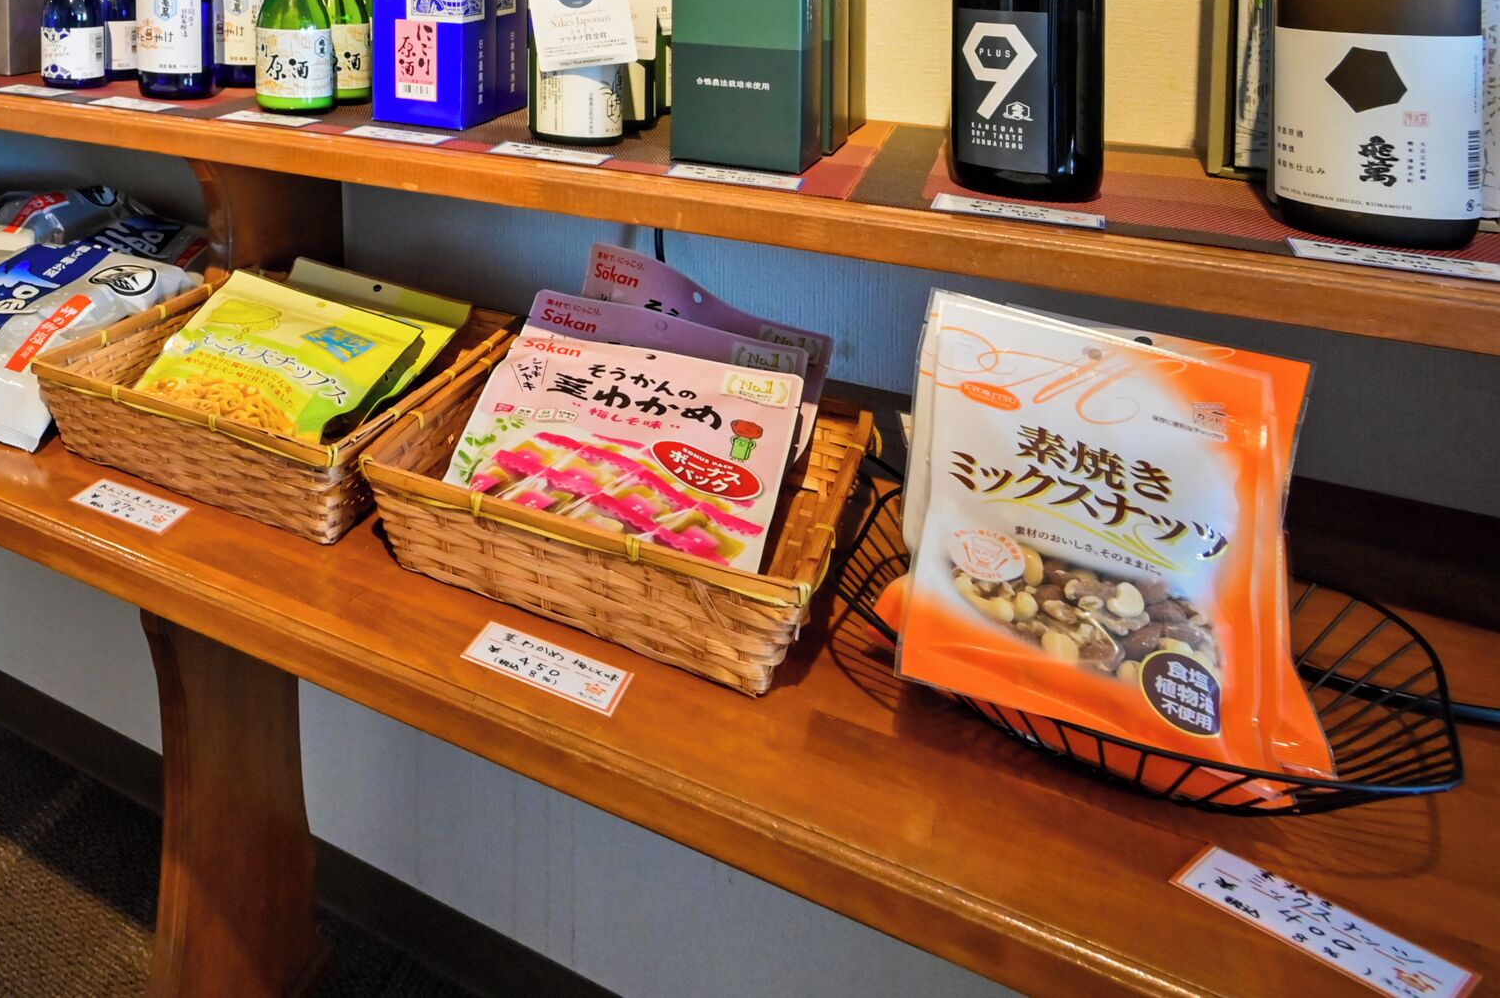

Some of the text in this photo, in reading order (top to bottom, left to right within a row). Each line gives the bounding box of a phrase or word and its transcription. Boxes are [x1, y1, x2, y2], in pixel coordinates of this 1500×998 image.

[962, 21, 1038, 121] 9
[979, 47, 1011, 59] PLUS
[587, 362, 698, 402] そうかんの
[739, 379, 774, 395] No.1
[546, 372, 723, 432] 茎わかめ
[587, 406, 664, 431] 梅しそ味
[667, 449, 743, 487] ボーナス
[682, 446, 735, 471] BONUS PACK
[1015, 424, 1173, 503] 素焼き
[674, 464, 731, 496] パック
[948, 450, 1230, 562] ミックスナッツ
[1014, 524, 1163, 577] 素材のおいしさ、そのままに。
[518, 656, 561, 678] 450
[1166, 660, 1211, 691] 食塩
[1155, 674, 1215, 716] 植物油
[1161, 700, 1214, 731] 不使用
[1278, 908, 1357, 953] 400
